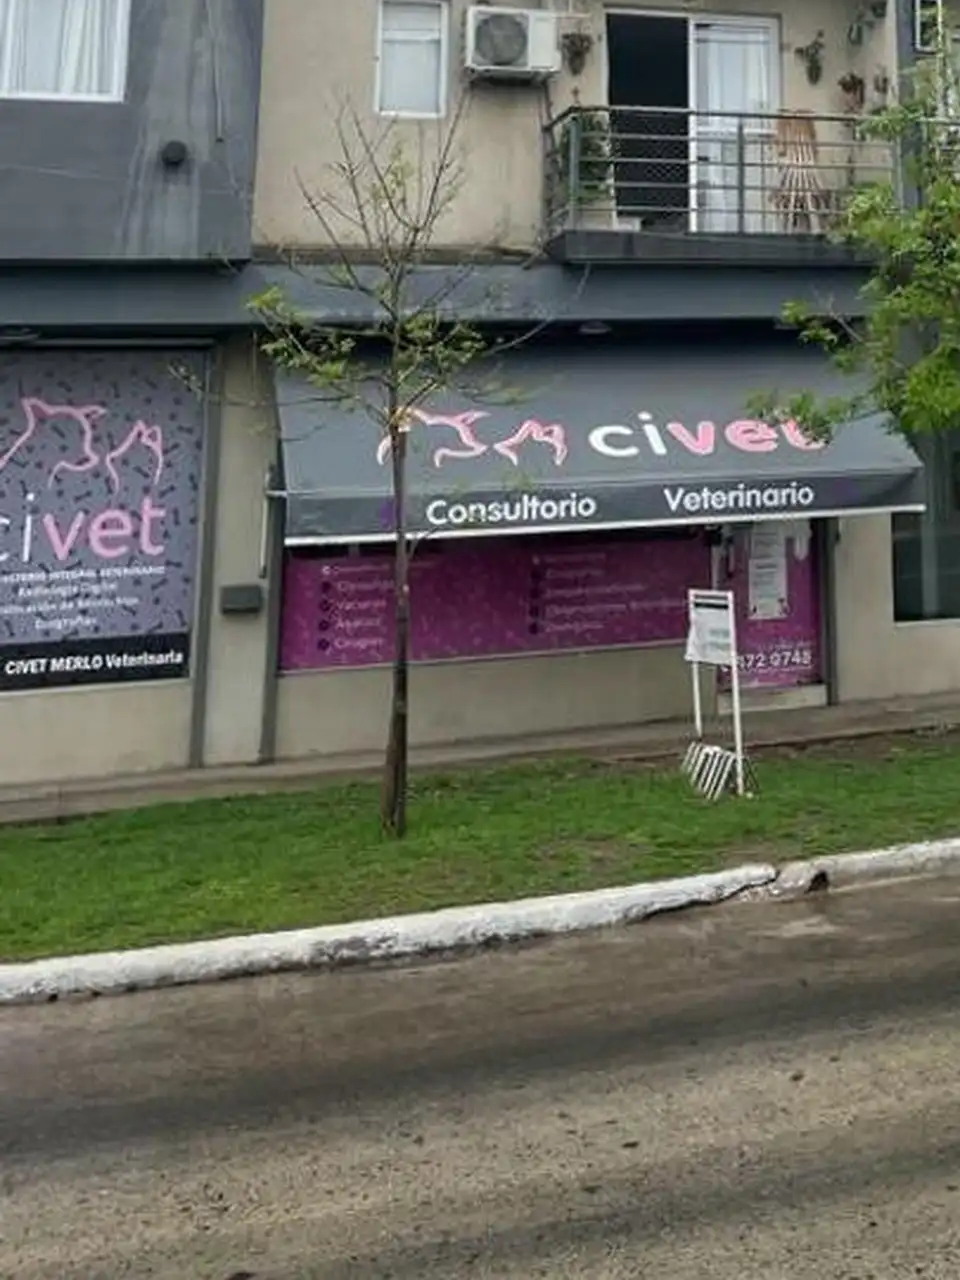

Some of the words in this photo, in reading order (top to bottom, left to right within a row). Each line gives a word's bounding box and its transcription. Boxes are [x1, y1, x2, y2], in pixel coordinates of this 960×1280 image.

[425, 492, 598, 526] Consultorio
[663, 481, 815, 513] Veterinario
[0, 492, 167, 563] ivet
[5, 658, 48, 675] CIVET
[50, 654, 103, 672] MERLO
[106, 649, 184, 669] Veterinaria
